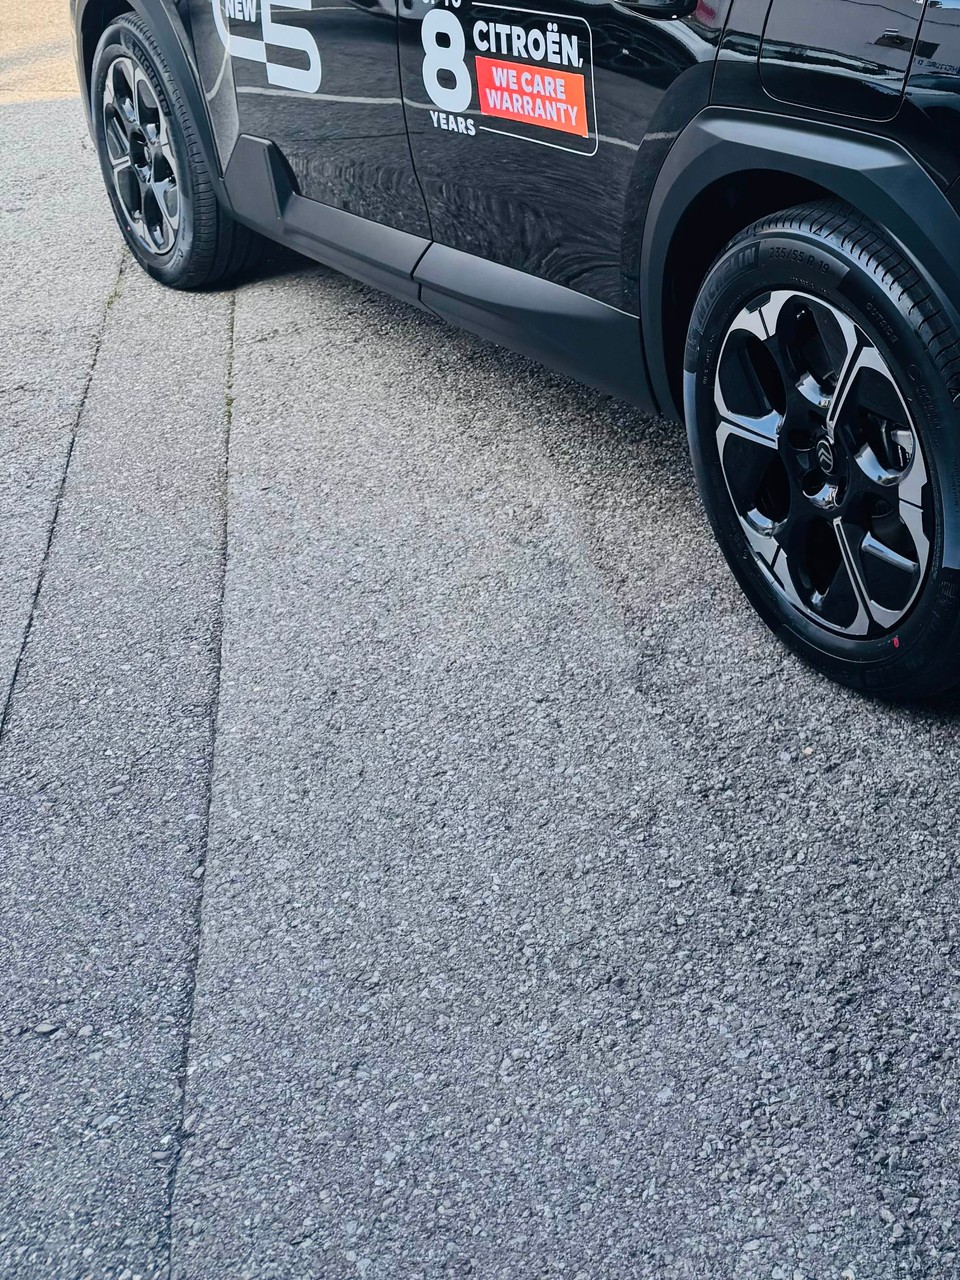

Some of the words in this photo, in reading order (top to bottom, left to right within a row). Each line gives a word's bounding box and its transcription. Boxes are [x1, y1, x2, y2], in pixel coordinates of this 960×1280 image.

[420, 8, 472, 113] 8
[133, 43, 171, 115] MICHELIN
[491, 66, 519, 91] WE
[520, 71, 566, 100] CARE
[429, 110, 476, 136] YEARS
[485, 87, 578, 126] WARRANTY
[769, 247, 805, 264] 235/55
[818, 260, 831, 274] 19
